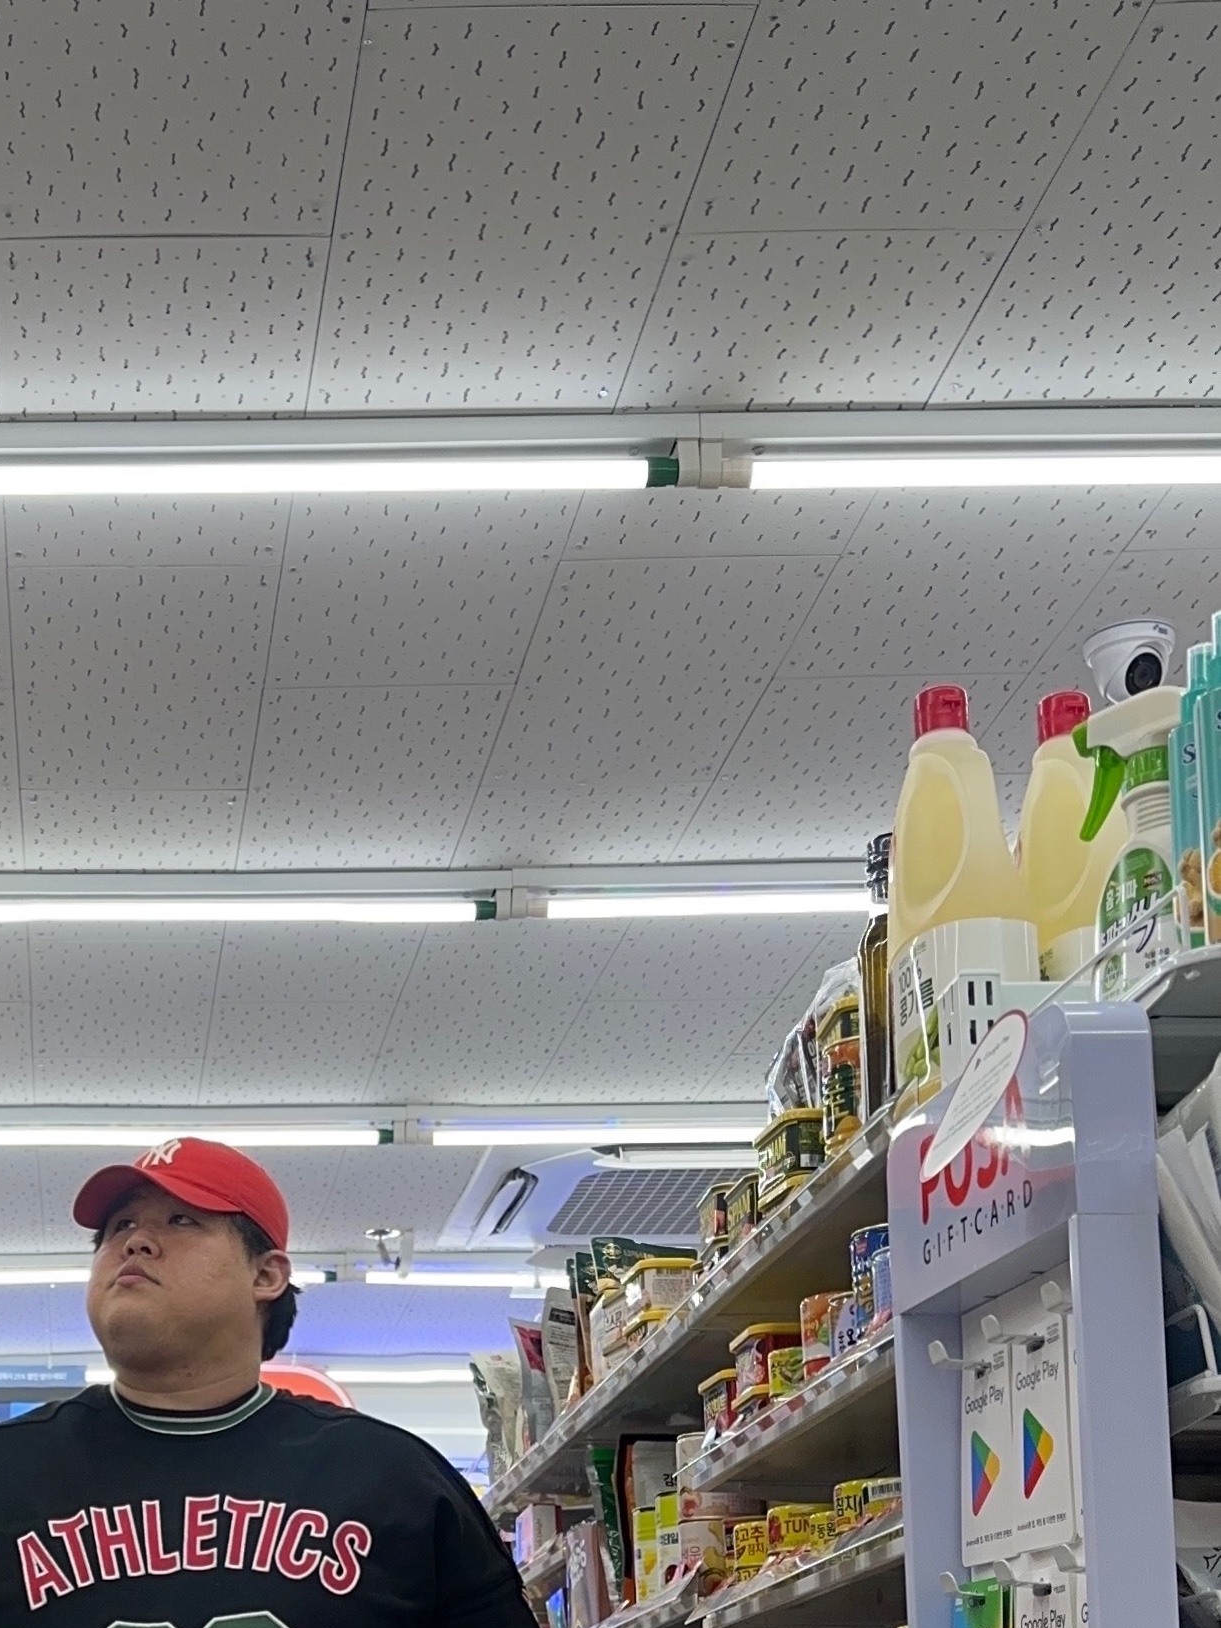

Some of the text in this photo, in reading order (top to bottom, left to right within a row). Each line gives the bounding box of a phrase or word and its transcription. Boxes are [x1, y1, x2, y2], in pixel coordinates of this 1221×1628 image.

[141, 1138, 182, 1169] NY
[1015, 1361, 1060, 1392] Google Play
[964, 1386, 1006, 1415] Google Play
[16, 1494, 373, 1611] ATHLETICS
